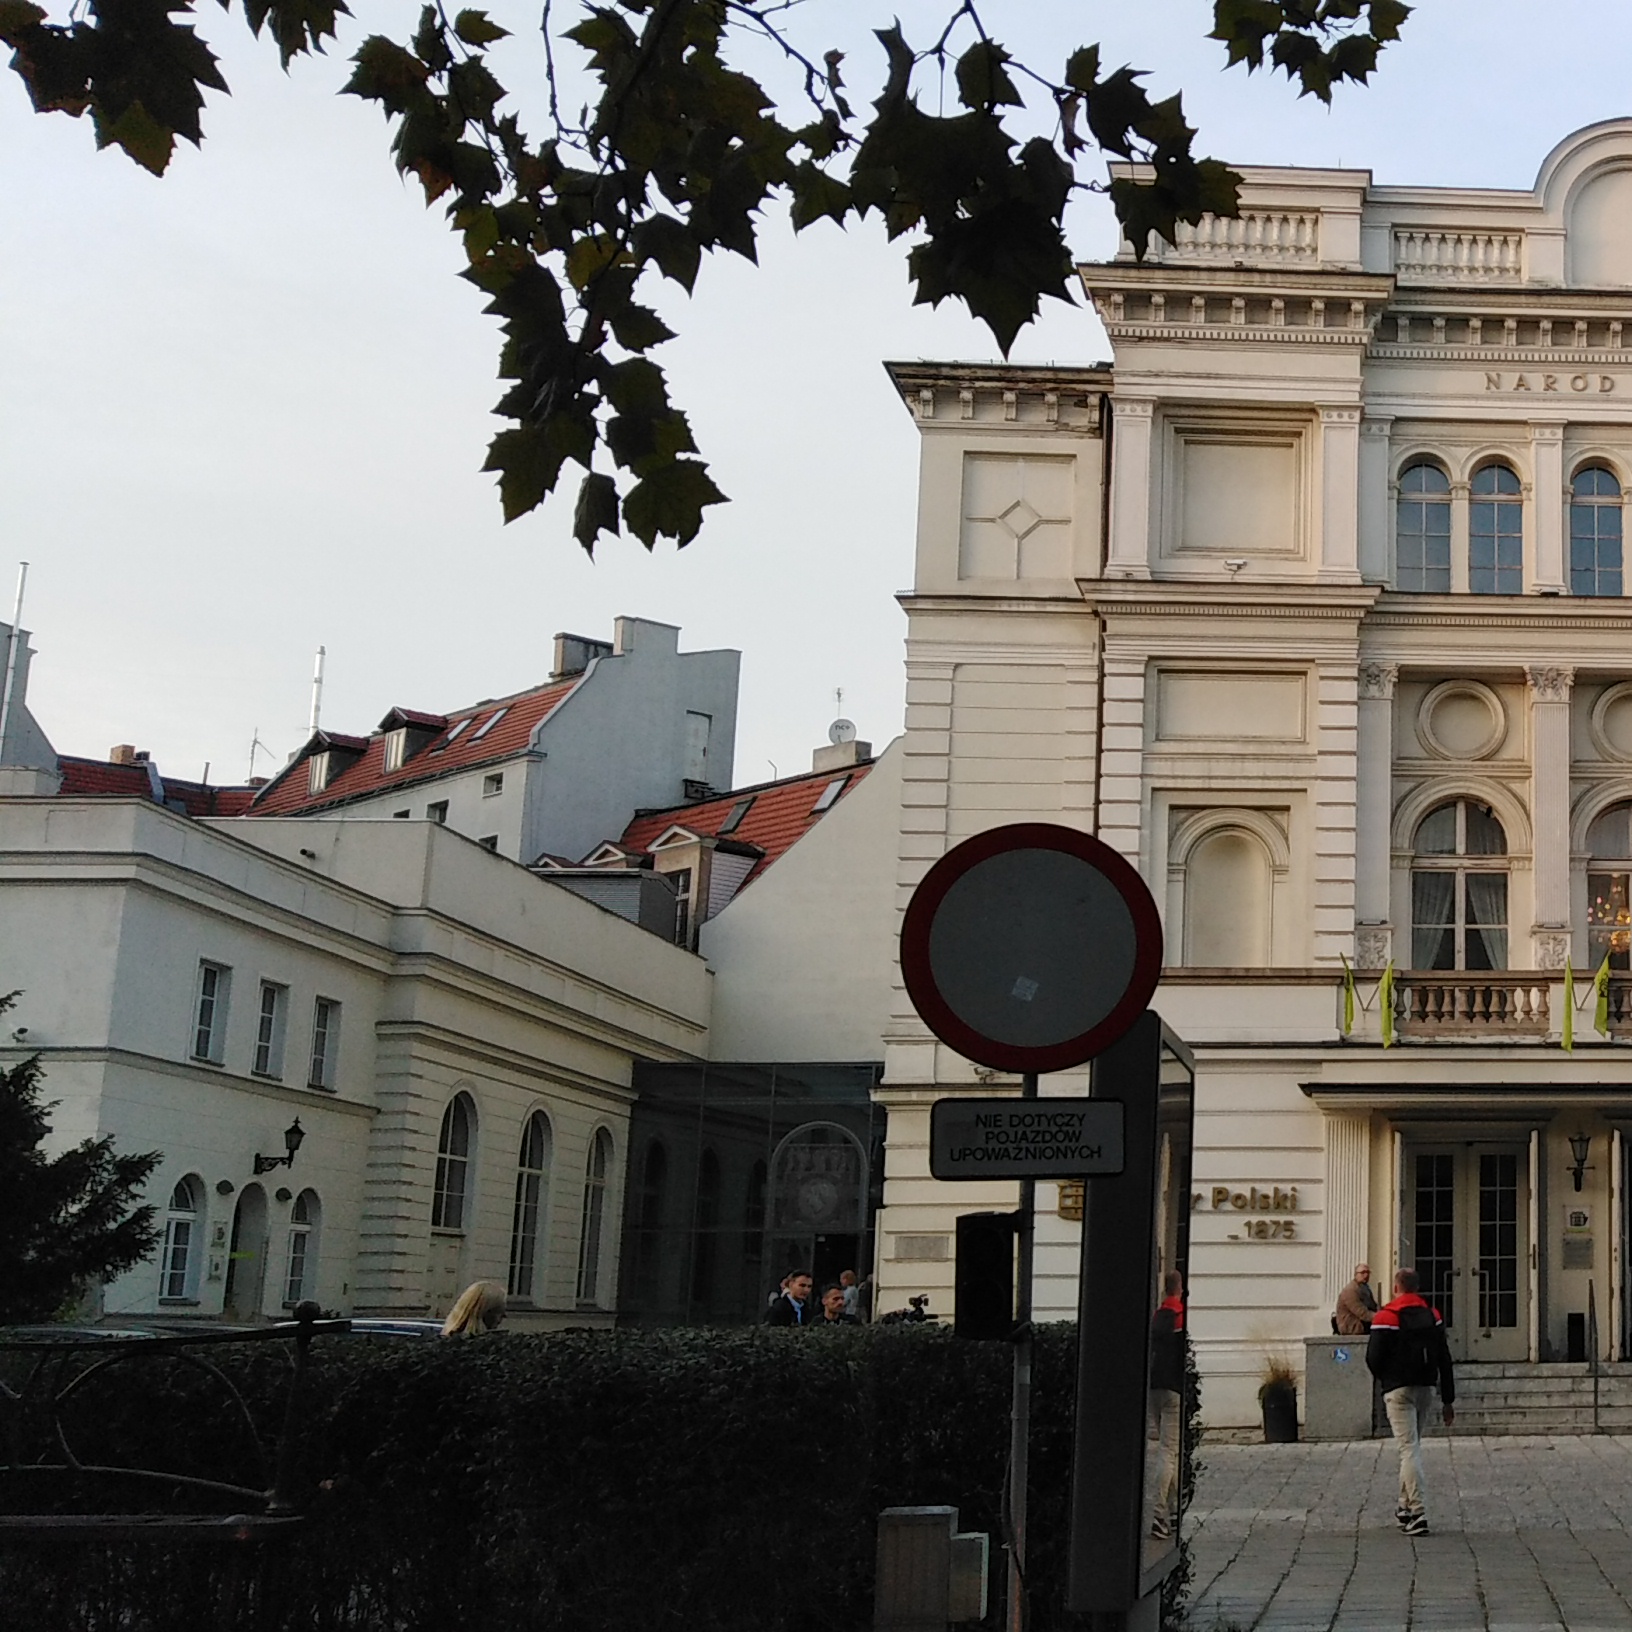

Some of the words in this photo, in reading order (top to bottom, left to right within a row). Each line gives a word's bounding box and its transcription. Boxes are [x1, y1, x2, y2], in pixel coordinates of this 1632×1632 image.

[1485, 371, 1615, 393] NARÓD
[975, 1113, 1003, 1128] NIE
[1009, 1113, 1086, 1128] DOTYCZY
[984, 1127, 1082, 1145] POJAZDÓW
[949, 1144, 1102, 1162] UPOWAŻNIONYCH
[1211, 1185, 1299, 1211] Polski
